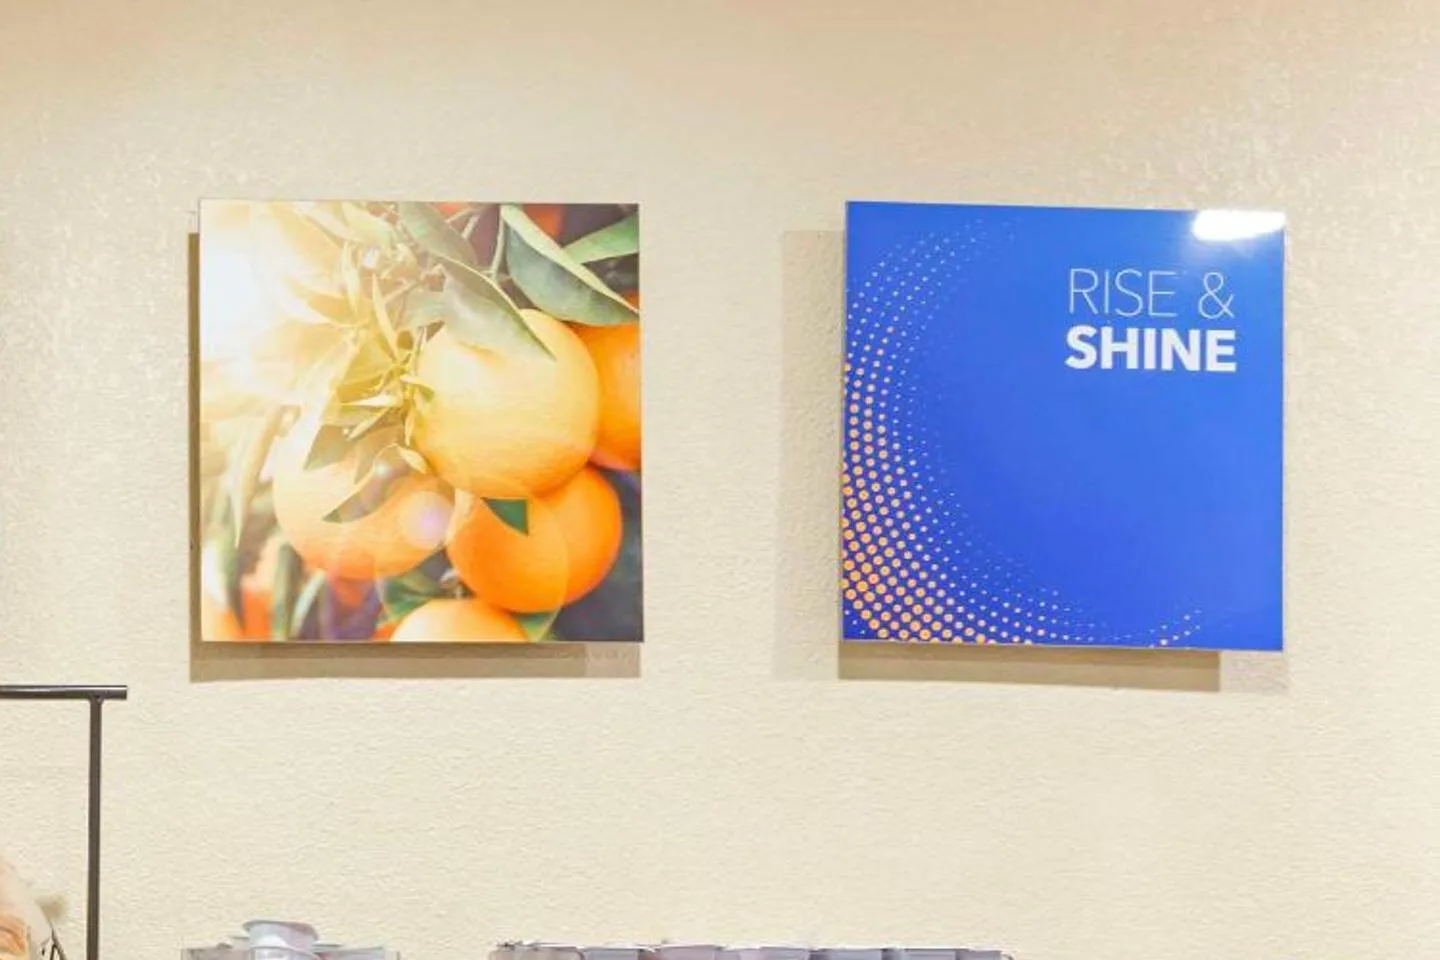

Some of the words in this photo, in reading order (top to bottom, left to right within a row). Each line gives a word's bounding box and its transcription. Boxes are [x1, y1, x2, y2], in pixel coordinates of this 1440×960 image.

[1069, 268, 1178, 317] RISE
[1198, 272, 1235, 319] &
[1065, 325, 1237, 372] SHINE
